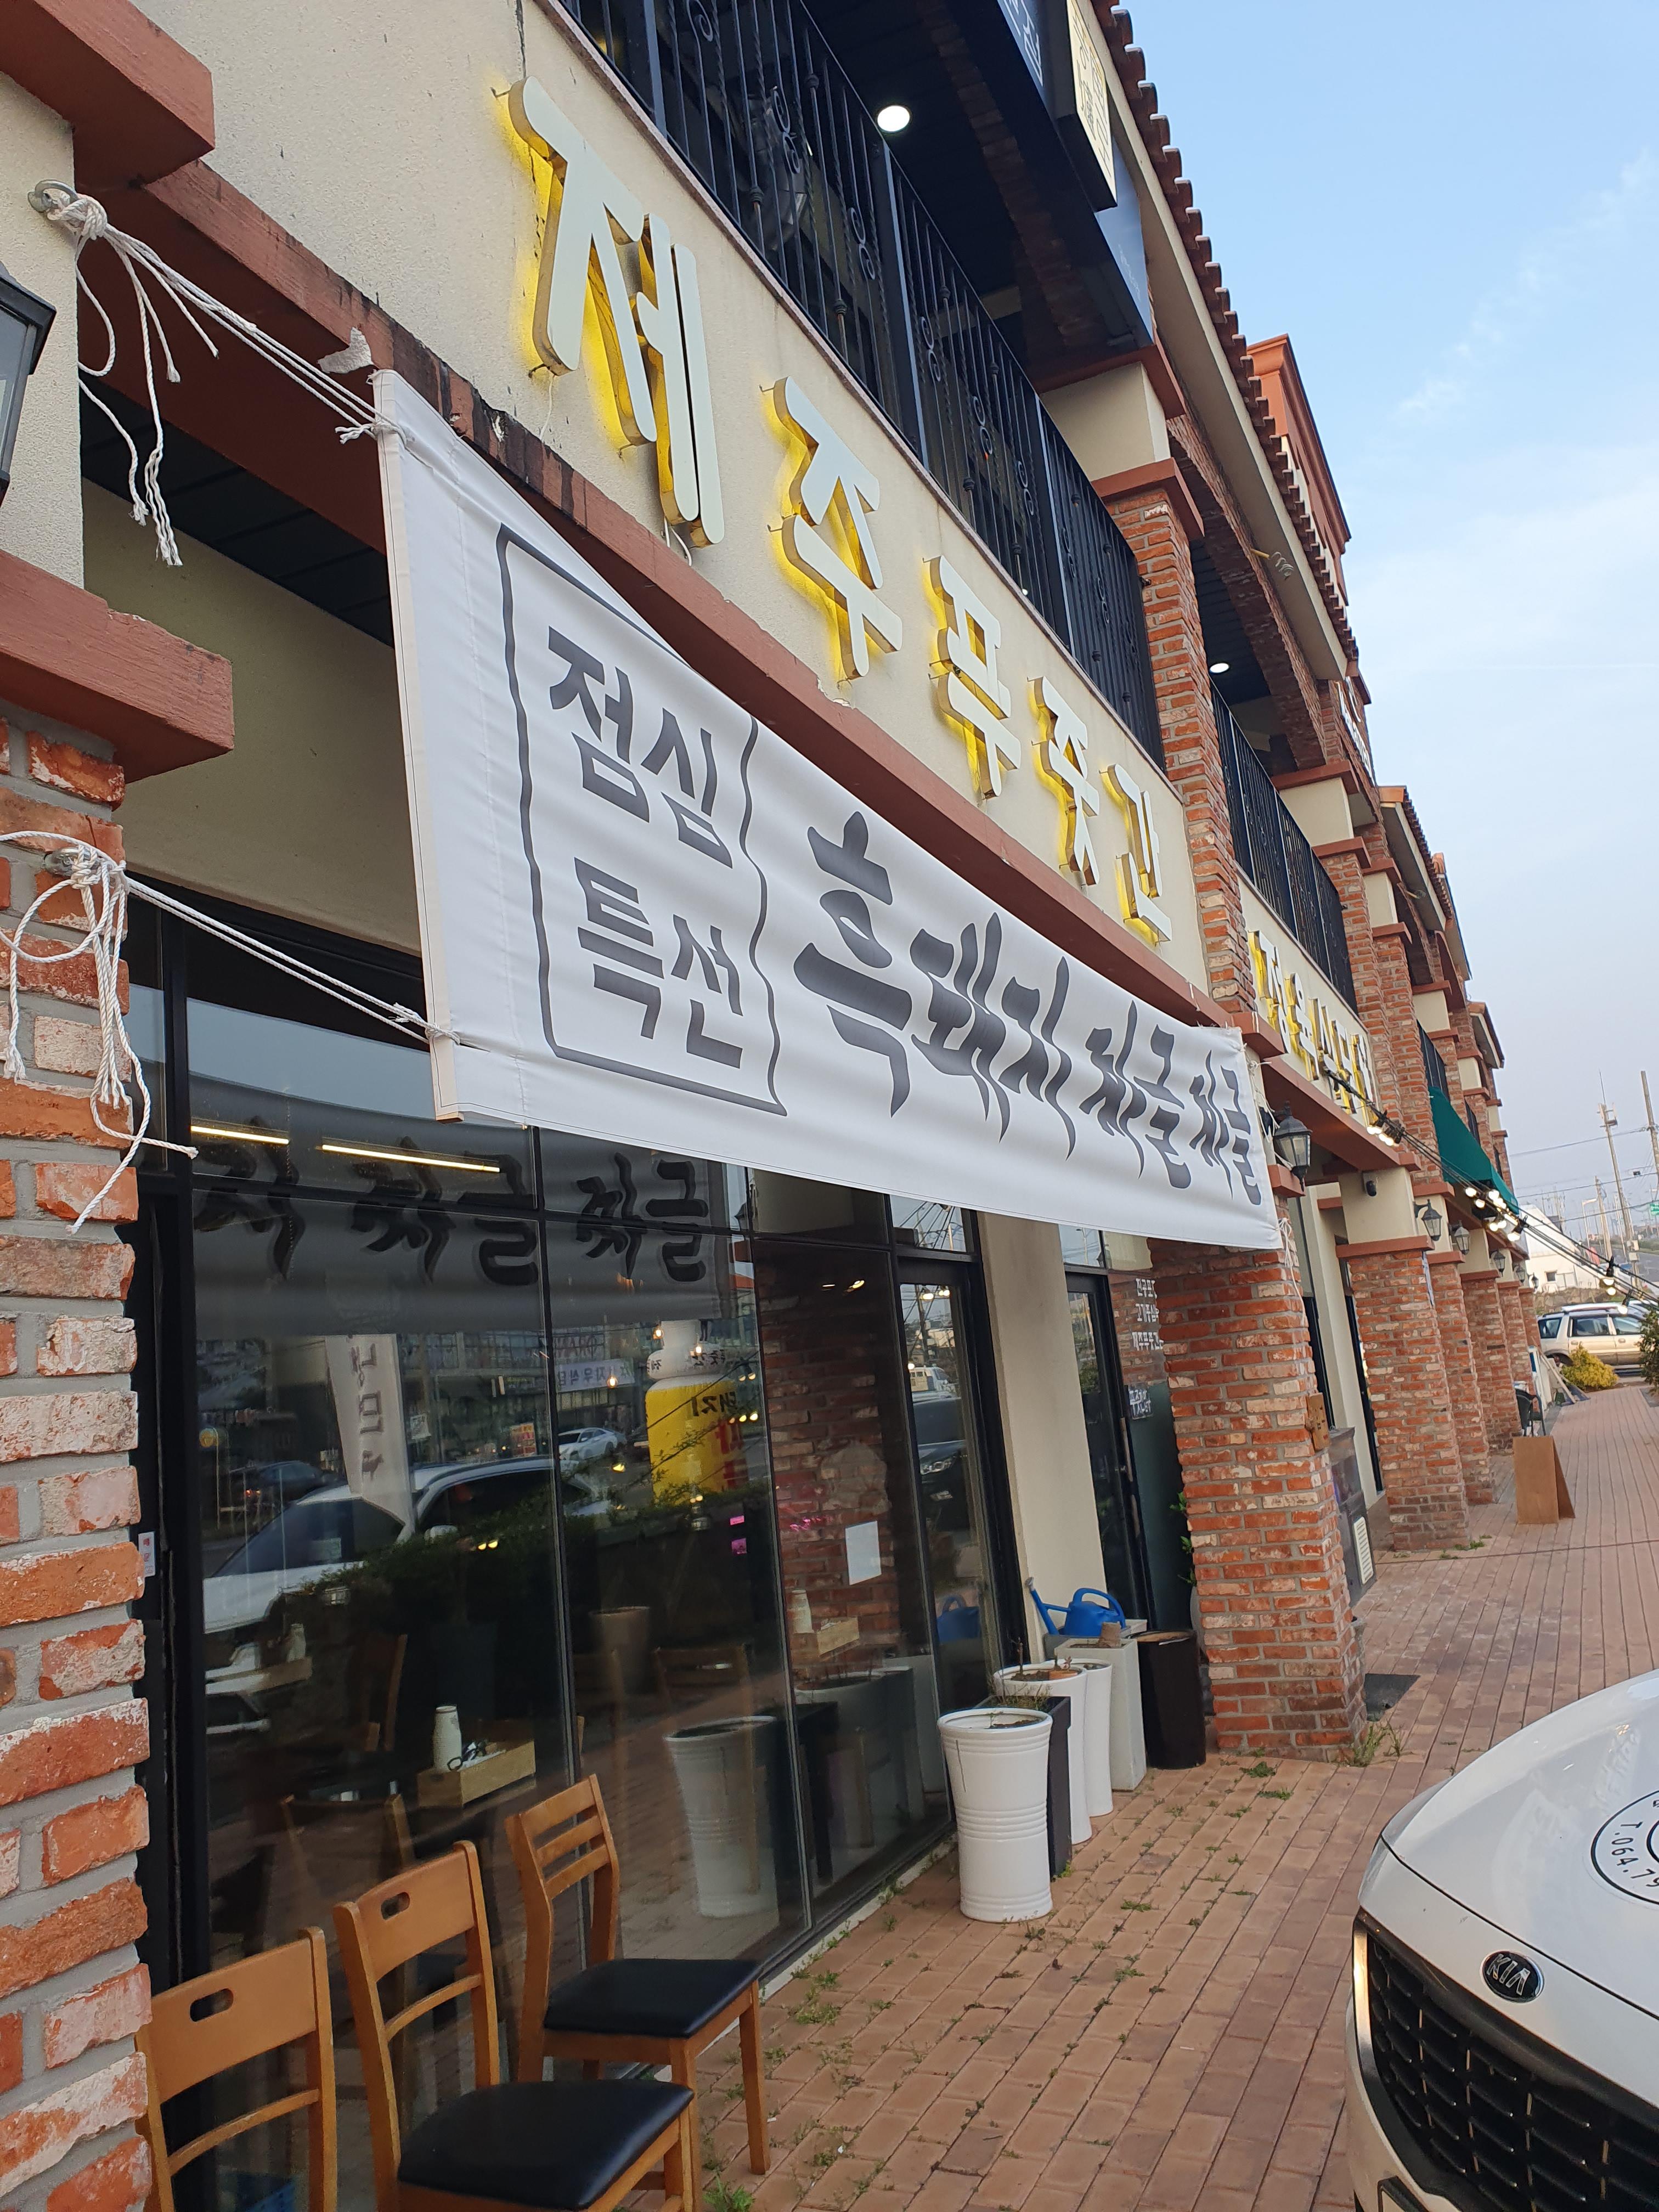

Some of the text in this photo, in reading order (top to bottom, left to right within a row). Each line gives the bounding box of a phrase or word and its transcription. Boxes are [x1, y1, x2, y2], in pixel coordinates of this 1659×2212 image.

[509, 76, 1172, 942] 제주푸줏간
[549, 626, 733, 868] 점심
[574, 857, 743, 1069] 특선
[1486, 1953, 1531, 1996] KIA
